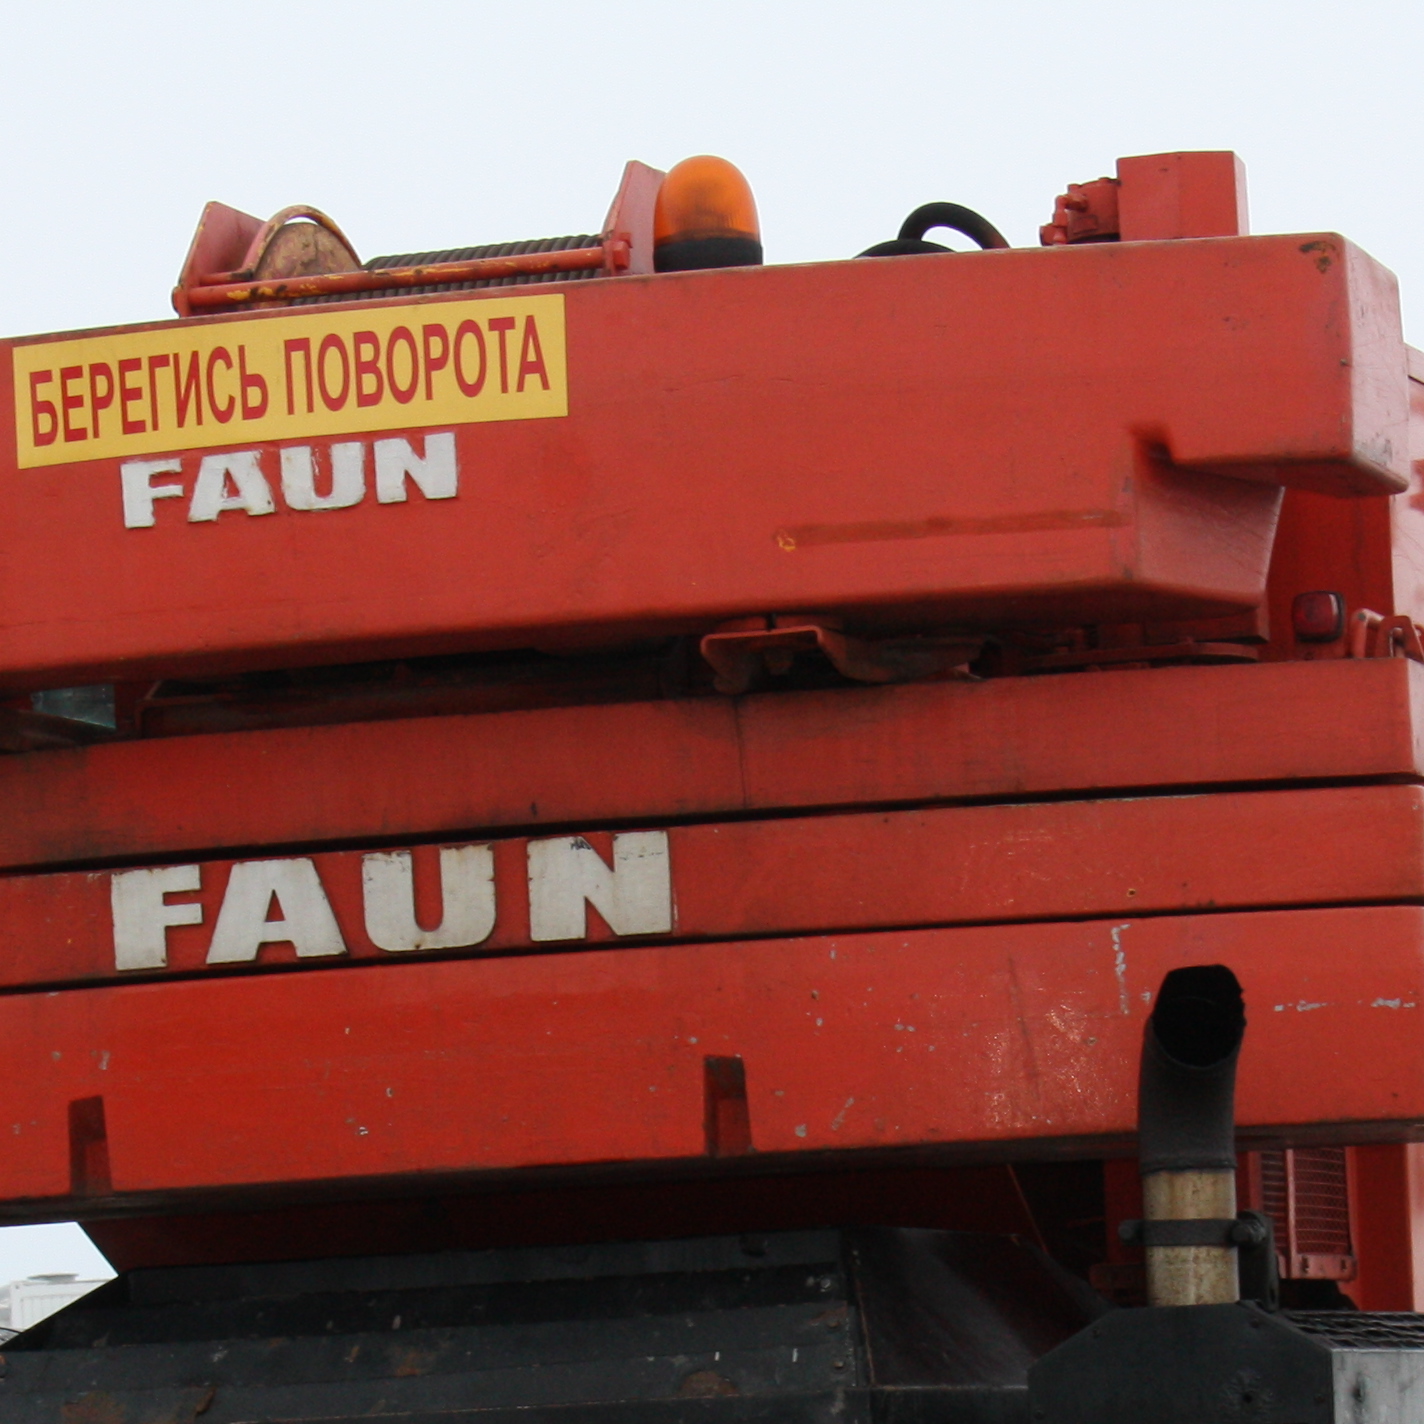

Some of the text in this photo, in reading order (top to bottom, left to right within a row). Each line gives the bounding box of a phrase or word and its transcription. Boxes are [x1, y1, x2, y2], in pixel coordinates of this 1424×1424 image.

[29, 314, 551, 448] БЕРЕГИСЬ ПОВОРОТА
[119, 431, 458, 530] FAUN
[110, 830, 673, 971] FAUN
